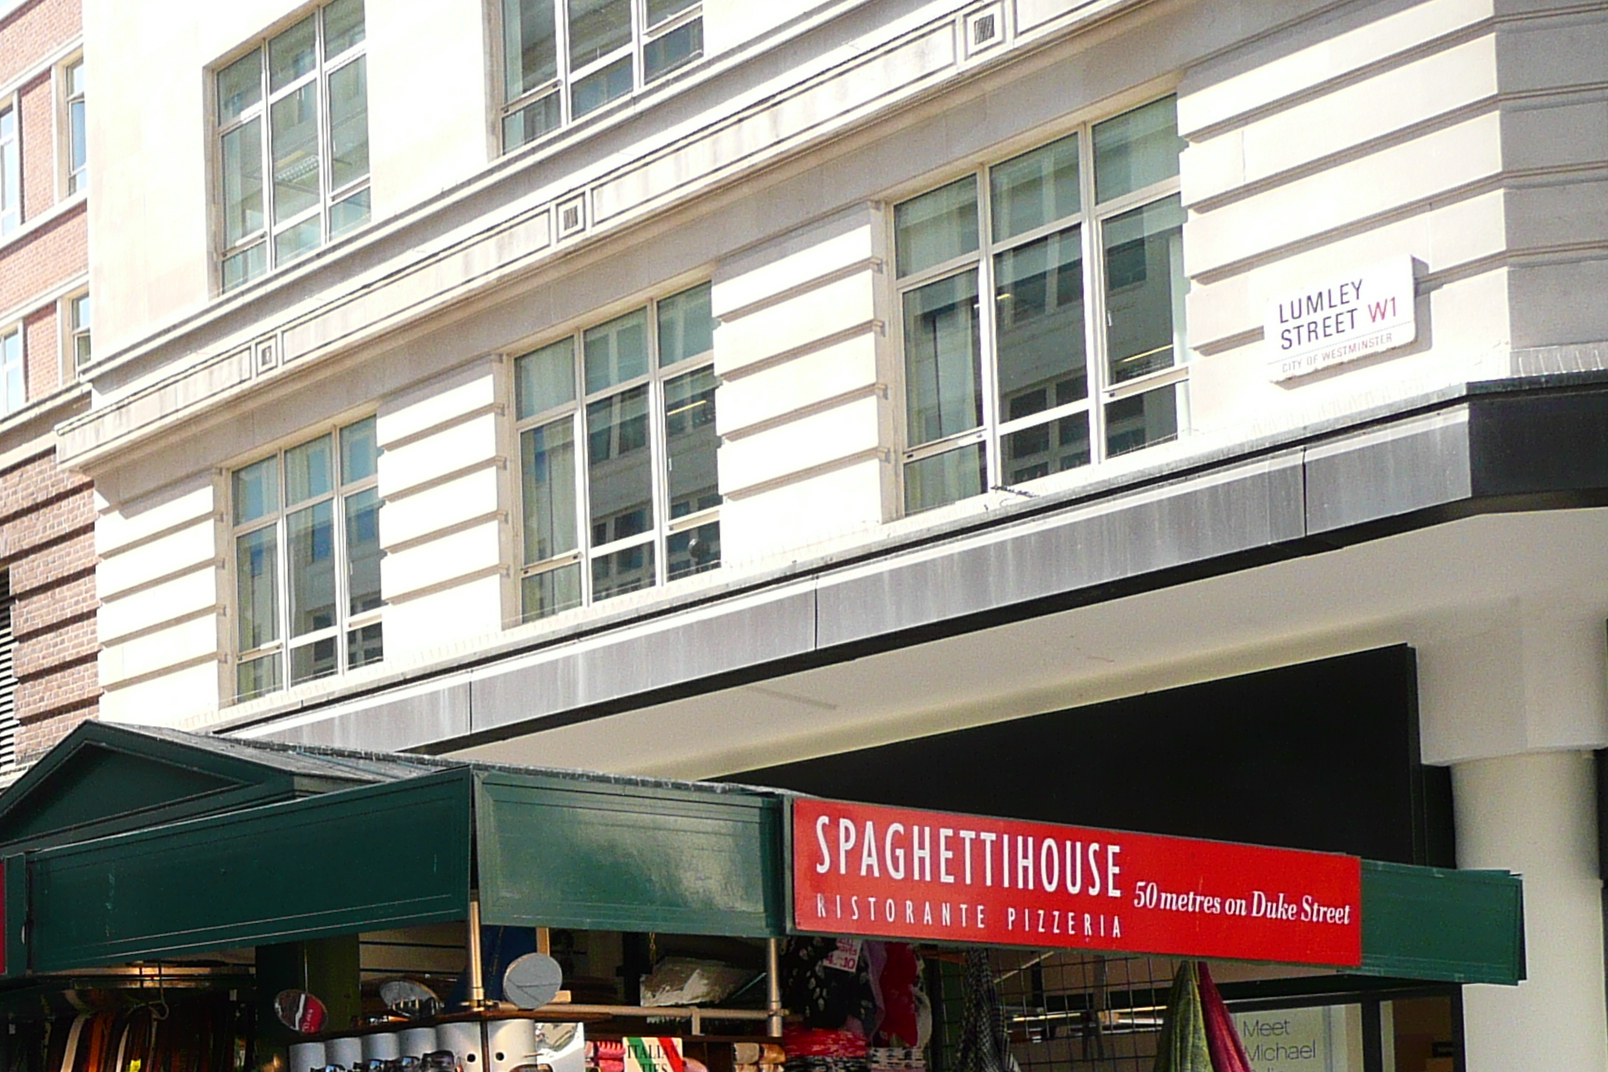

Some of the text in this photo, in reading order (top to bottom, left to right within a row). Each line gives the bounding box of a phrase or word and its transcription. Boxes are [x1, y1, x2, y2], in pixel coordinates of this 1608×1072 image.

[1278, 278, 1363, 324] LUMLEY
[1281, 296, 1396, 350] STREET W1
[1282, 332, 1393, 374] CITY OF WESTMINSTER
[815, 815, 1122, 897] SPAGHETTIHOUSE
[816, 892, 1122, 938] RISTORANTE PIZZERIA
[1133, 881, 1351, 925] 50 metres on Duke Street
[1243, 1019, 1290, 1038] Meet
[1245, 1039, 1316, 1062] Michael
